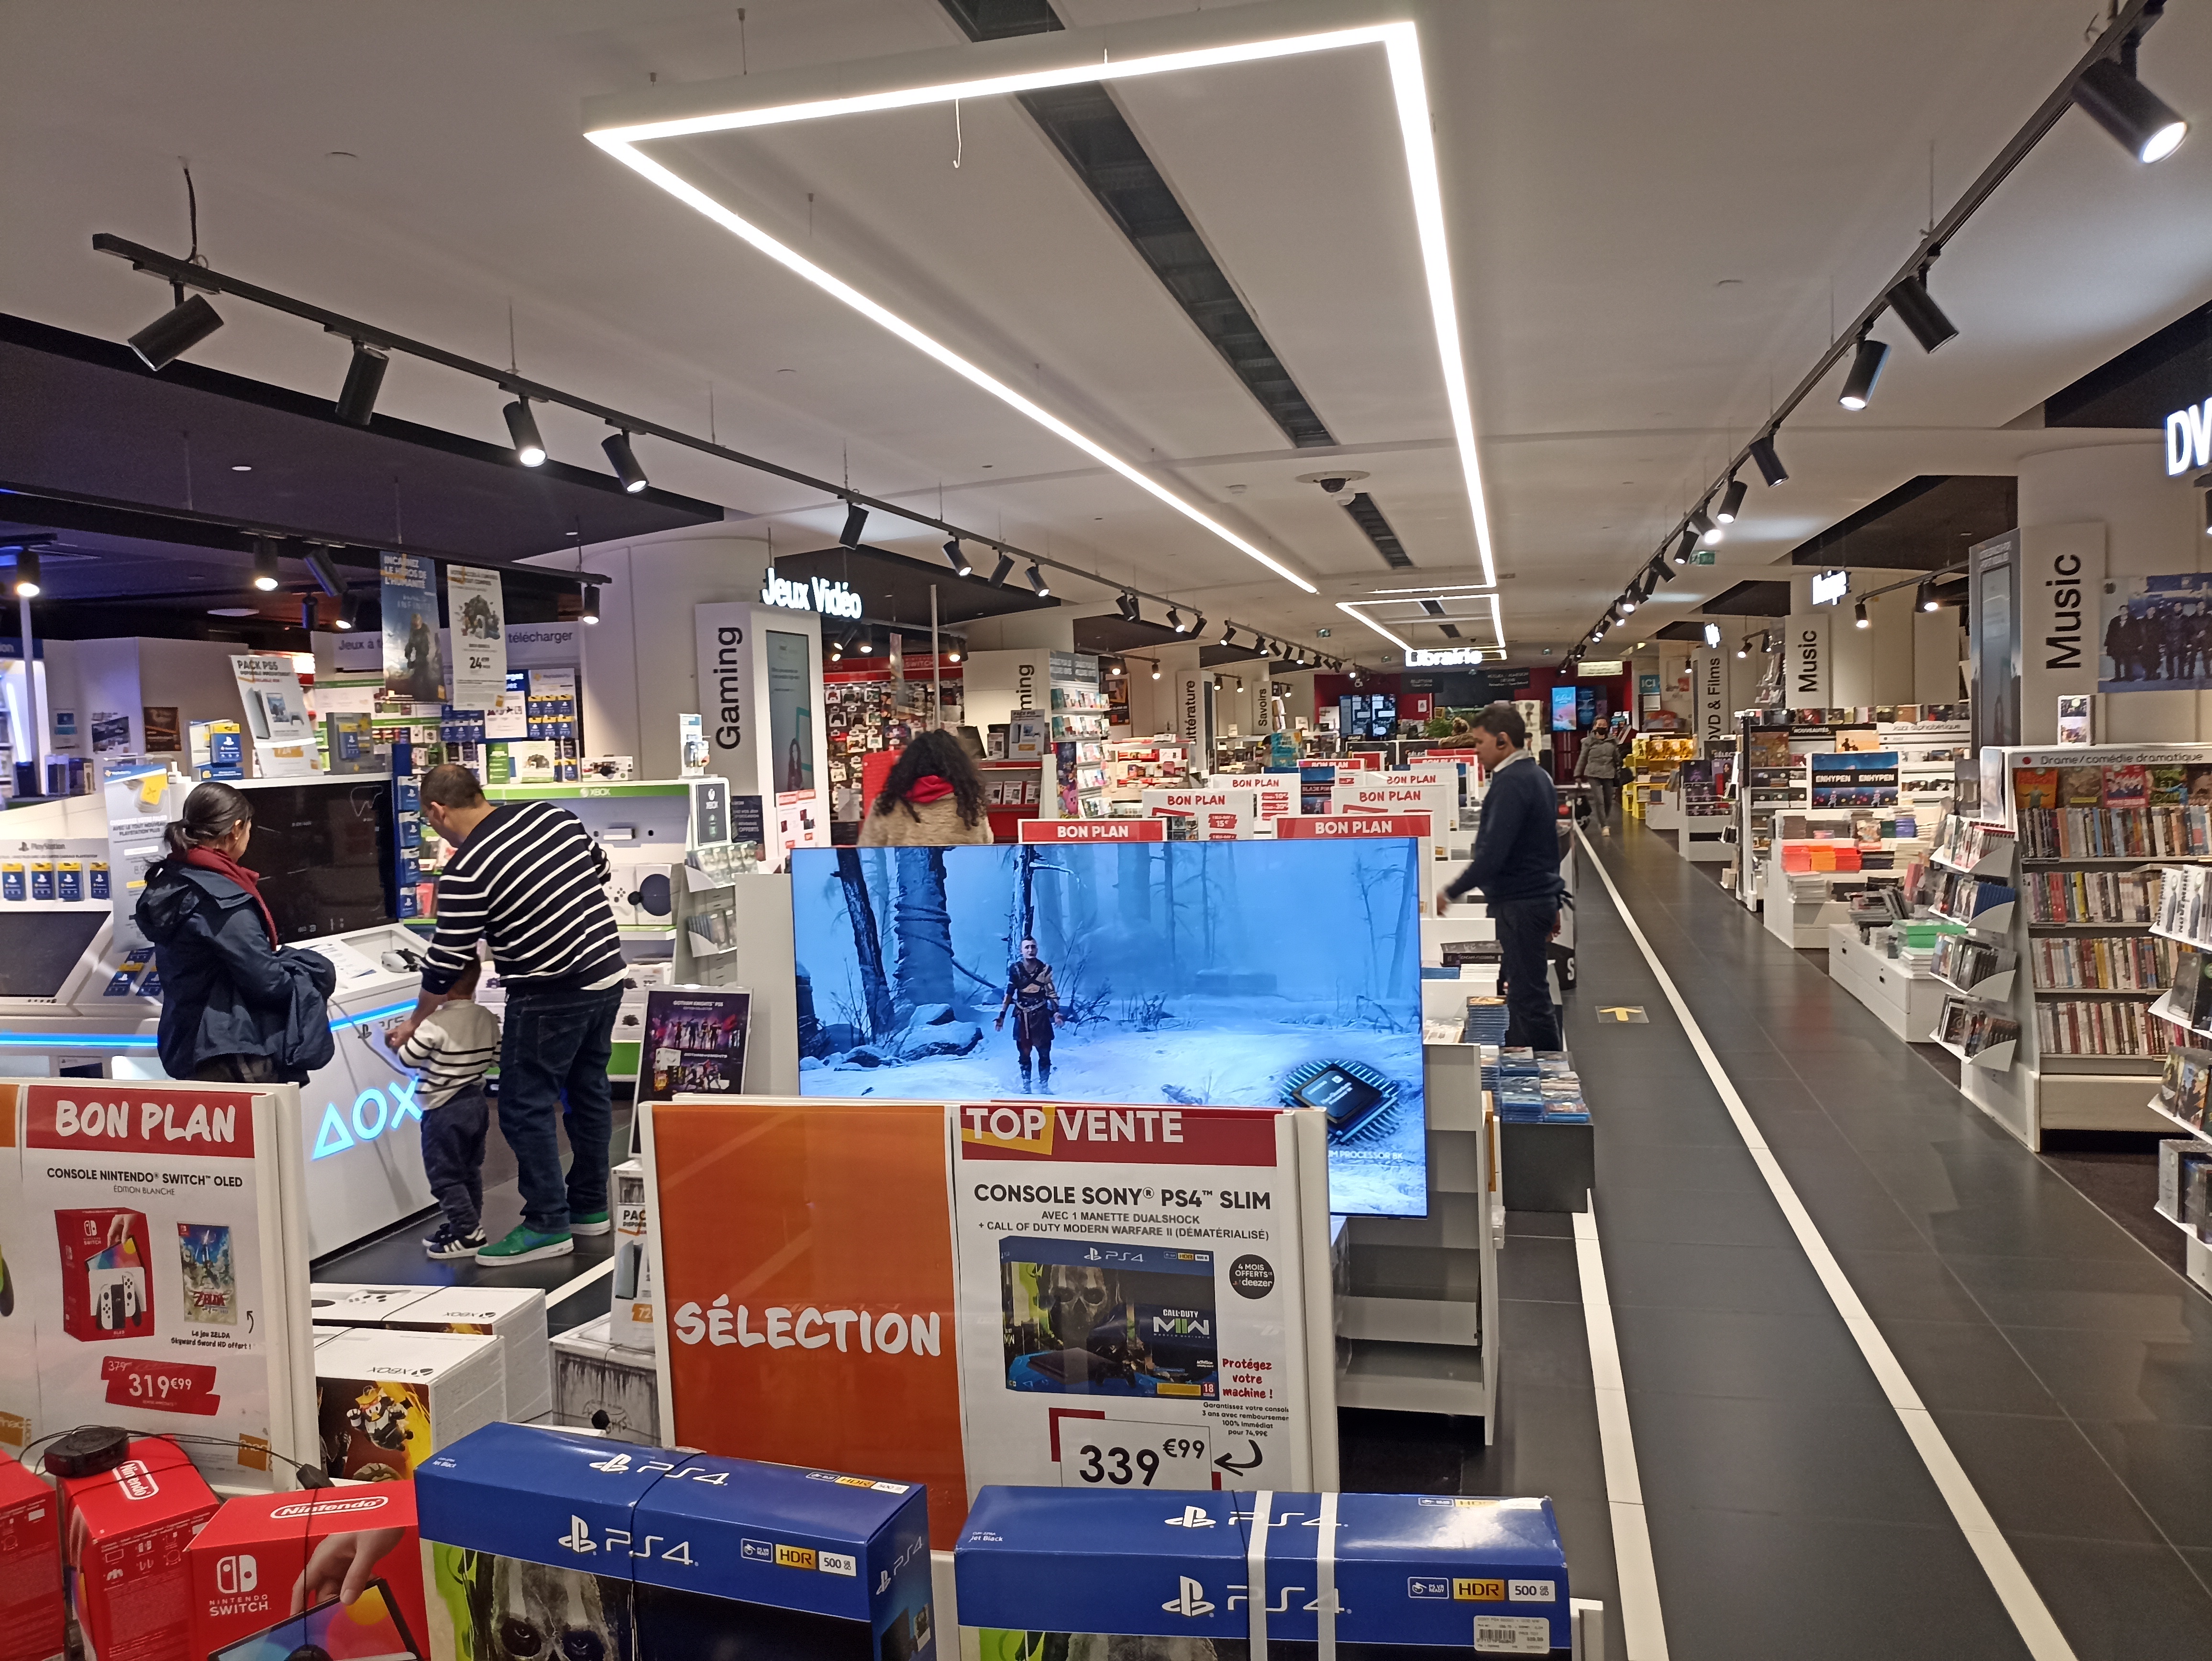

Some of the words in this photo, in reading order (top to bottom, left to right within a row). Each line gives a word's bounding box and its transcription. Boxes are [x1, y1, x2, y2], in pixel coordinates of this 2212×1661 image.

[2166, 397, 2212, 476] DV
[763, 567, 810, 611] Jeux
[812, 576, 862, 619] Vidéo
[2046, 554, 2081, 669] Music
[508, 631, 573, 644] télécharger
[1405, 648, 1483, 667] Librairie
[1798, 630, 1817, 692] Music
[237, 660, 261, 670] PACK
[262, 661, 278, 670] PS5
[1707, 657, 1721, 695] Films
[713, 627, 743, 750] Gaming
[1016, 664, 1035, 710] ming
[1184, 680, 1197, 741] ittérature
[1258, 688, 1268, 727] Savoirs
[2136, 752, 2203, 763] dramatique
[1232, 779, 1250, 787] BON
[1253, 778, 1280, 787] PLAN
[1411, 775, 1436, 784] PLAN
[1815, 774, 1851, 783] ENHYPEN
[1858, 773, 1895, 783] ENHYPEN
[590, 787, 611, 797] XBOX
[1360, 791, 1385, 803] BON
[1388, 790, 1421, 801] PLAN
[1167, 795, 1192, 806] BON
[1195, 795, 1225, 805] PLAN
[1057, 825, 1088, 838] BON
[1092, 826, 1129, 838] PLAN
[1315, 821, 1347, 835] BON
[1350, 820, 1393, 834] PLAN
[31, 842, 66, 851] PlayStation
[55, 1100, 129, 1139] BON
[141, 1102, 236, 1143] PLAN
[966, 1107, 1046, 1141] TOP
[1057, 1109, 1184, 1143] VENTE
[1340, 1150, 1391, 1160] PROCESSOR
[47, 1167, 98, 1180] CONSOLE
[213, 1175, 243, 1187] OLED
[113, 1184, 141, 1194] ÉDITION
[142, 1186, 176, 1196] BLANCHE
[974, 1184, 1076, 1205] CONSOLE
[1219, 1190, 1271, 1210] SLIM
[623, 1209, 646, 1221] PAC
[1041, 1211, 1070, 1220] AVEC
[1072, 1212, 1077, 1220] 1
[1081, 1212, 1129, 1223] MANETTE
[1133, 1213, 1200, 1224] DUALSHOCK
[987, 1221, 1014, 1231] CALL
[1016, 1222, 1030, 1231] OF
[1033, 1222, 1061, 1233] DUTY
[1063, 1224, 1109, 1234] MODERN
[1112, 1225, 1163, 1236] WARFARE
[1166, 1227, 1172, 1236] II
[1175, 1226, 1269, 1241] (DÉMATÉRIALISÉ)
[1106, 1250, 1144, 1262] PS4
[1241, 1278, 1272, 1287] deezer
[674, 1294, 941, 1356] SÉLECTION
[171, 1337, 196, 1346] Skyward
[197, 1340, 216, 1348] Sword
[367, 1366, 412, 1375] XBOX
[1222, 1358, 1272, 1371] Protégez
[1232, 1373, 1263, 1384] votre
[1203, 1383, 1214, 1393] 18
[1223, 1387, 1266, 1399] machine
[1203, 1402, 1244, 1410] Garantissez
[1239, 1413, 1289, 1421] remboursemen
[637, 1461, 730, 1485] PS4
[841, 1477, 871, 1486] HDR
[280, 1500, 377, 1516] Nintendo
[1228, 1511, 1341, 1526] PS4
[605, 1527, 693, 1565] PS4
[780, 1549, 812, 1565] HDR
[824, 1557, 841, 1569] 500
[893, 1536, 923, 1575] PS4
[1459, 1583, 1499, 1596] HDR
[1515, 1585, 1537, 1596] 500
[209, 1594, 268, 1605] NINTENDO
[1226, 1584, 1345, 1614] PS4
[209, 1601, 269, 1617] SWITCH
